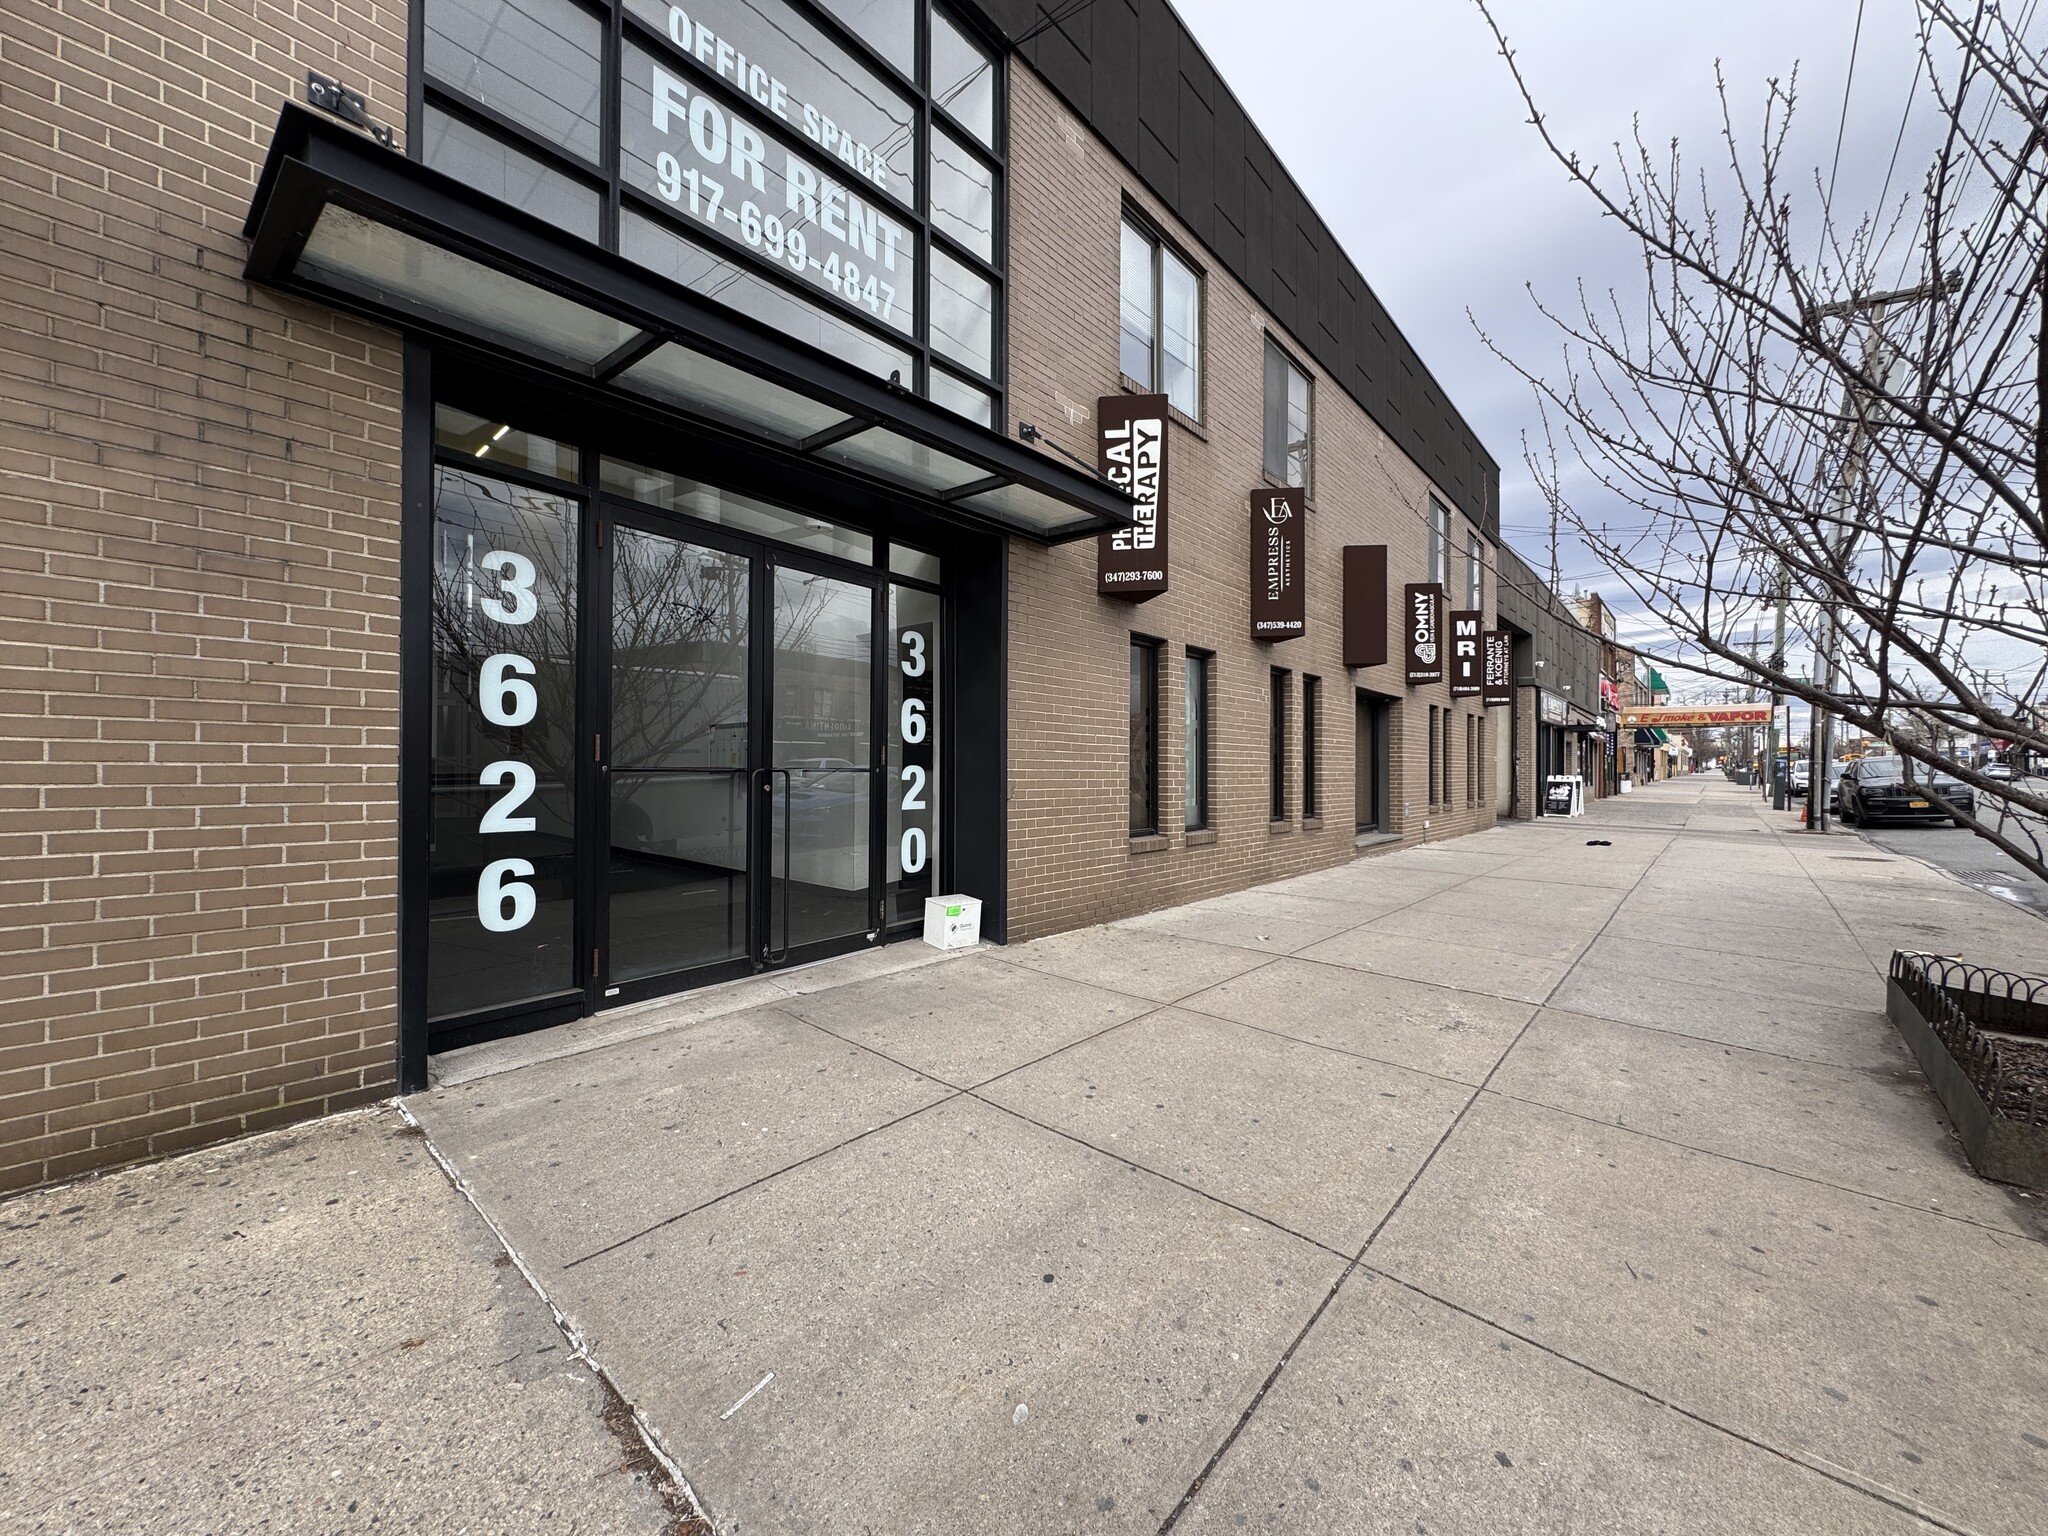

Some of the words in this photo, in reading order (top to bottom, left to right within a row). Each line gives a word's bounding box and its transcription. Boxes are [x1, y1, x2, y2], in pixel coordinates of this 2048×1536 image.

[668, 5, 788, 122] OFFICE
[802, 102, 887, 192] SPACE
[651, 64, 766, 195] FOR
[785, 152, 902, 273] RENT
[656, 151, 896, 320] 917-699-4847
[1136, 427, 1159, 547] THERAPY
[1104, 570, 1163, 583] (347)293-7600
[1267, 526, 1279, 600] EMPRESS
[1414, 592, 1429, 643] OMNY
[1456, 620, 1477, 677] MRI
[1486, 636, 1495, 686] FERRANTE
[1495, 640, 1503, 677] KOENIG
[1495, 678, 1503, 686] &
[477, 550, 539, 933] 3626
[1640, 713, 1650, 723] E
[1698, 713, 1706, 721] &
[1707, 710, 1768, 722] VAPOR
[900, 630, 927, 875] 3620
